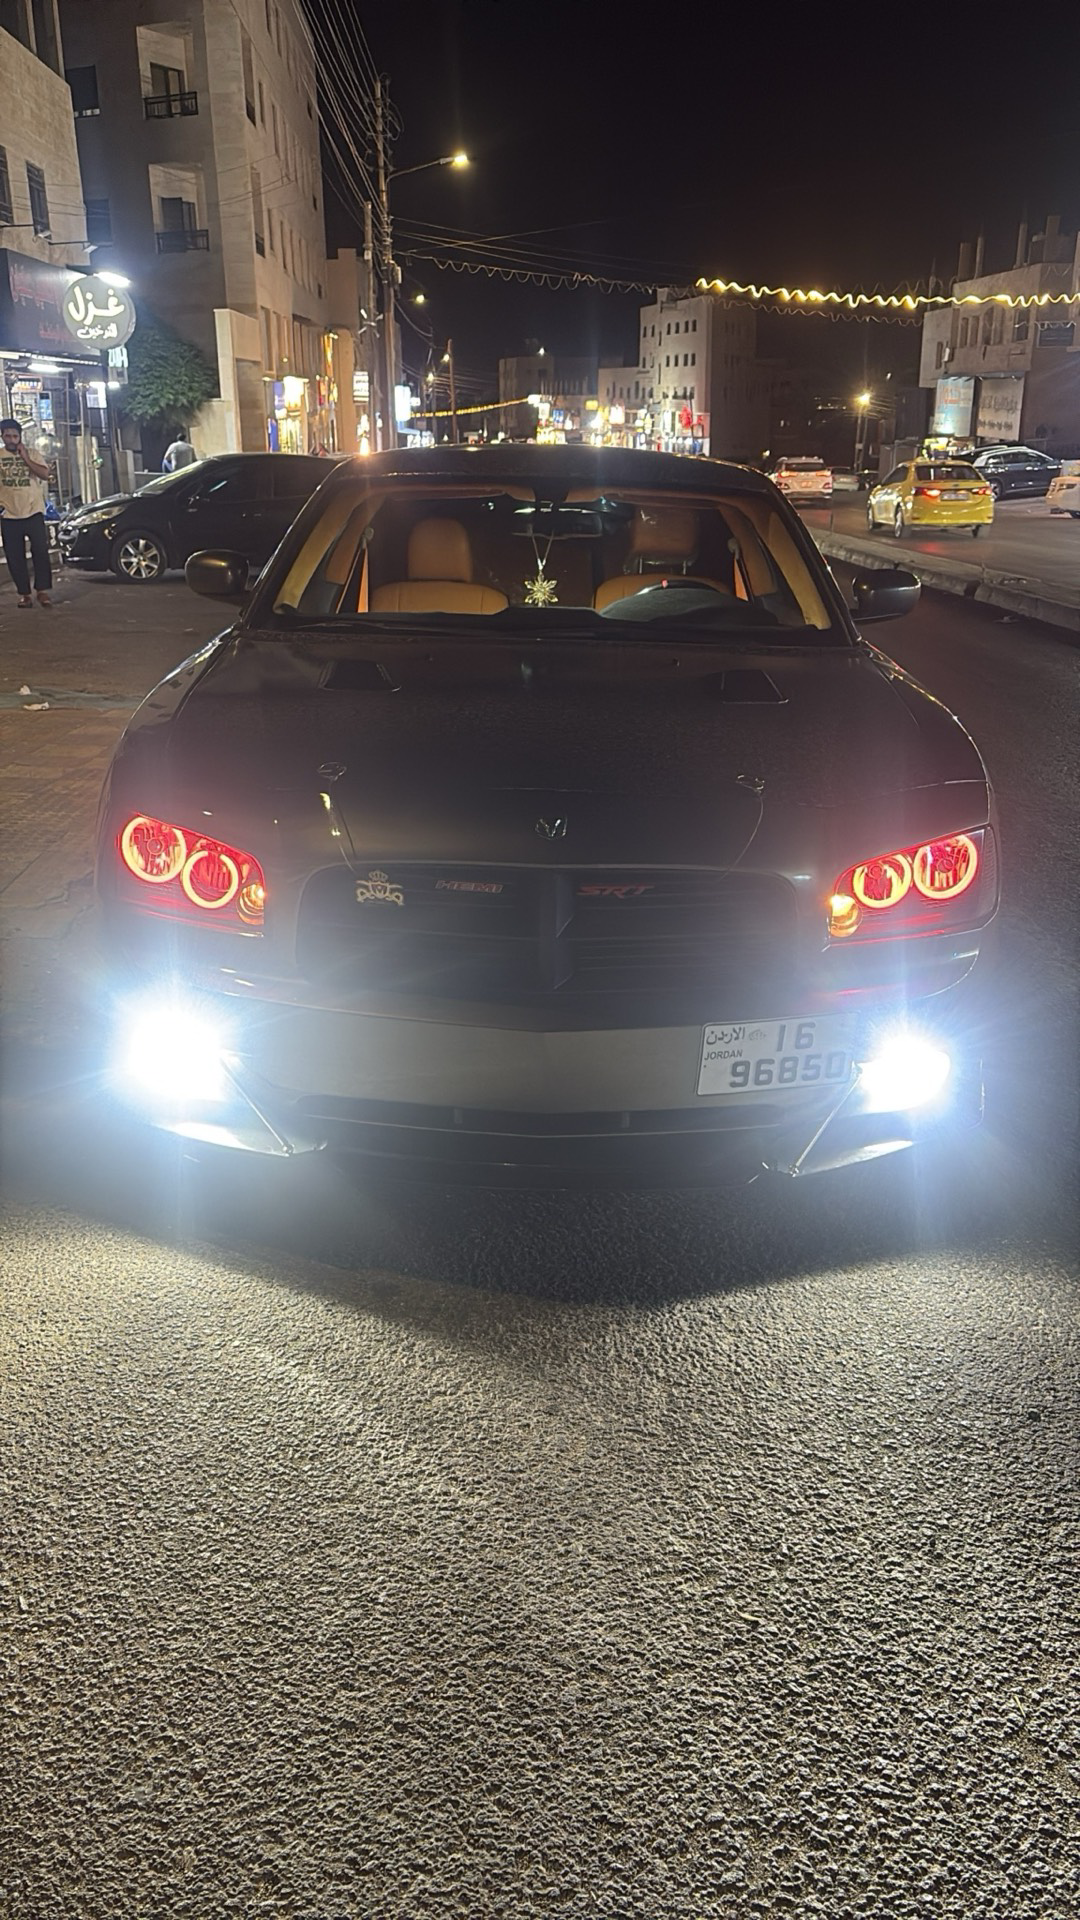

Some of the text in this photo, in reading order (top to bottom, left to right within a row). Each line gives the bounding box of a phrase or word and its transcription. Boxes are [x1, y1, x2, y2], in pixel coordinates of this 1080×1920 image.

[68, 286, 125, 325] غزل
[434, 879, 505, 894] HEMI
[575, 884, 656, 900] SRT
[776, 1021, 816, 1052] 16
[704, 1049, 743, 1061] JORDAN
[729, 1051, 847, 1089] 96850
